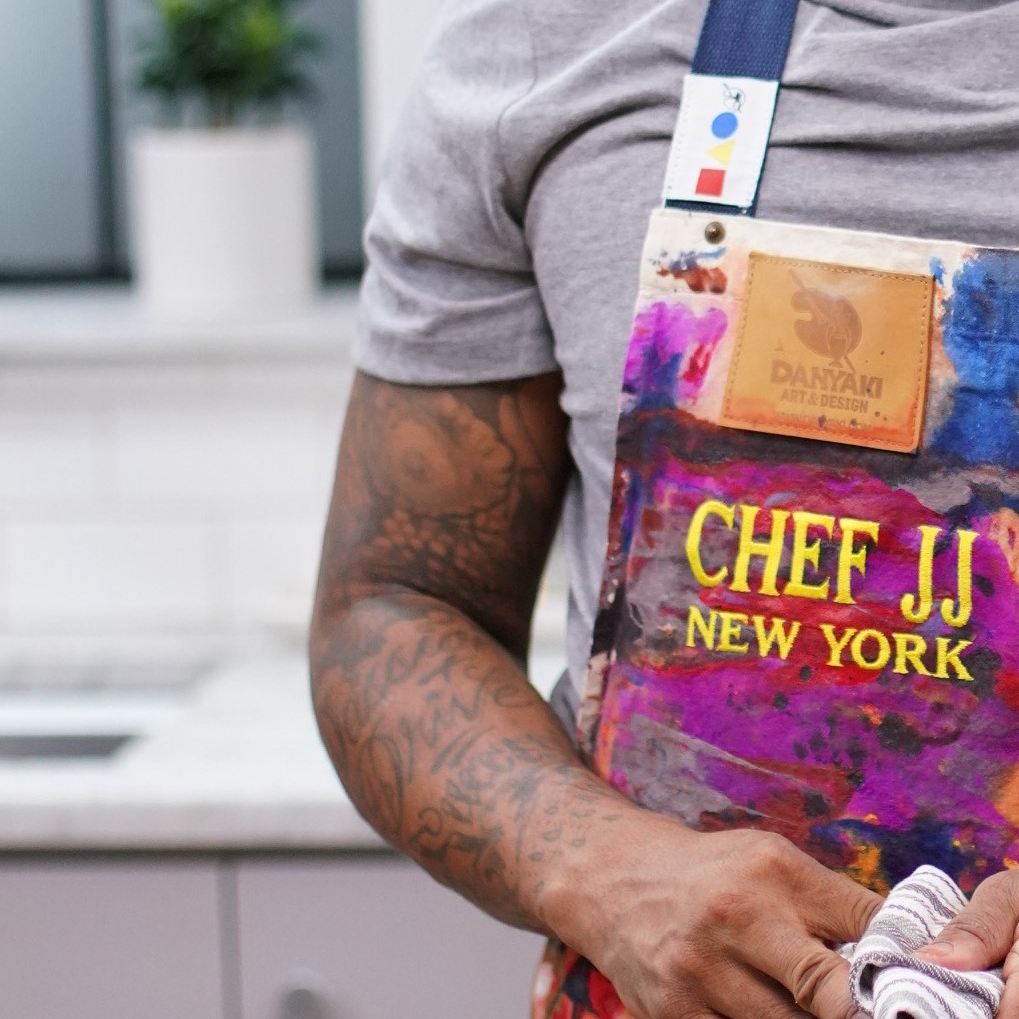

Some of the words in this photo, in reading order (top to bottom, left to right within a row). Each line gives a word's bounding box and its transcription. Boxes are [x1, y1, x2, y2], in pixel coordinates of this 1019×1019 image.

[770, 359, 884, 400] DANYAKI
[780, 389, 807, 404] ART
[808, 392, 818, 406] &
[820, 394, 869, 414] DESIGN
[685, 499, 880, 605] CHEF
[901, 525, 980, 628] JJ
[686, 605, 801, 660] NEW
[820, 624, 975, 681] YORK
